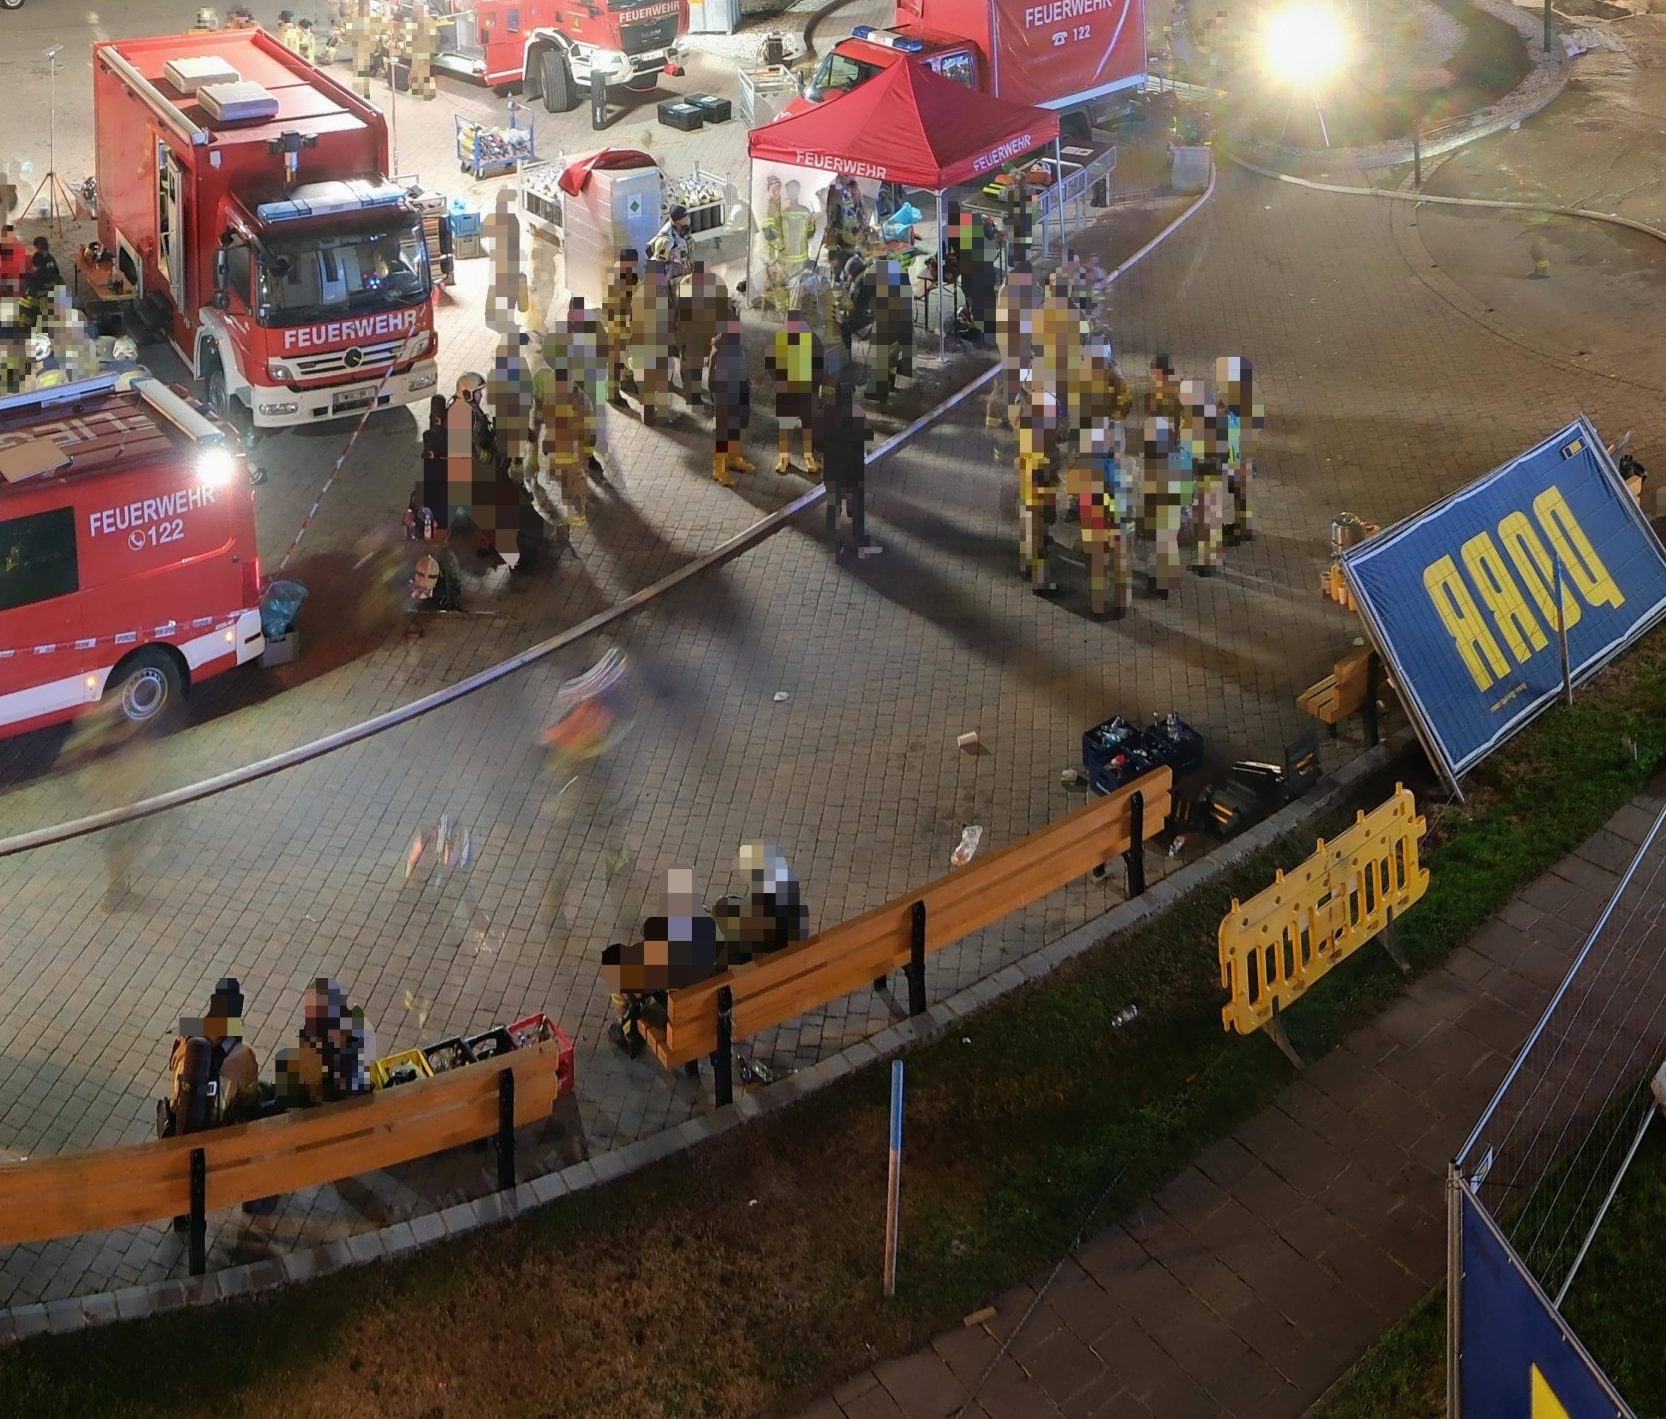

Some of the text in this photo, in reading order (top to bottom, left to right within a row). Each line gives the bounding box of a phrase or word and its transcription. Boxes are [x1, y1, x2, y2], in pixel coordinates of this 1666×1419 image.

[619, 0, 681, 23] FEUERWEHR
[1072, 25, 1091, 42] 122
[795, 150, 887, 180] FEUERWEHR
[973, 134, 1031, 172] FEUERWEHR
[284, 309, 417, 349] FEUERWEHR
[89, 485, 216, 536] FEUERWEHR
[147, 519, 185, 547] 122
